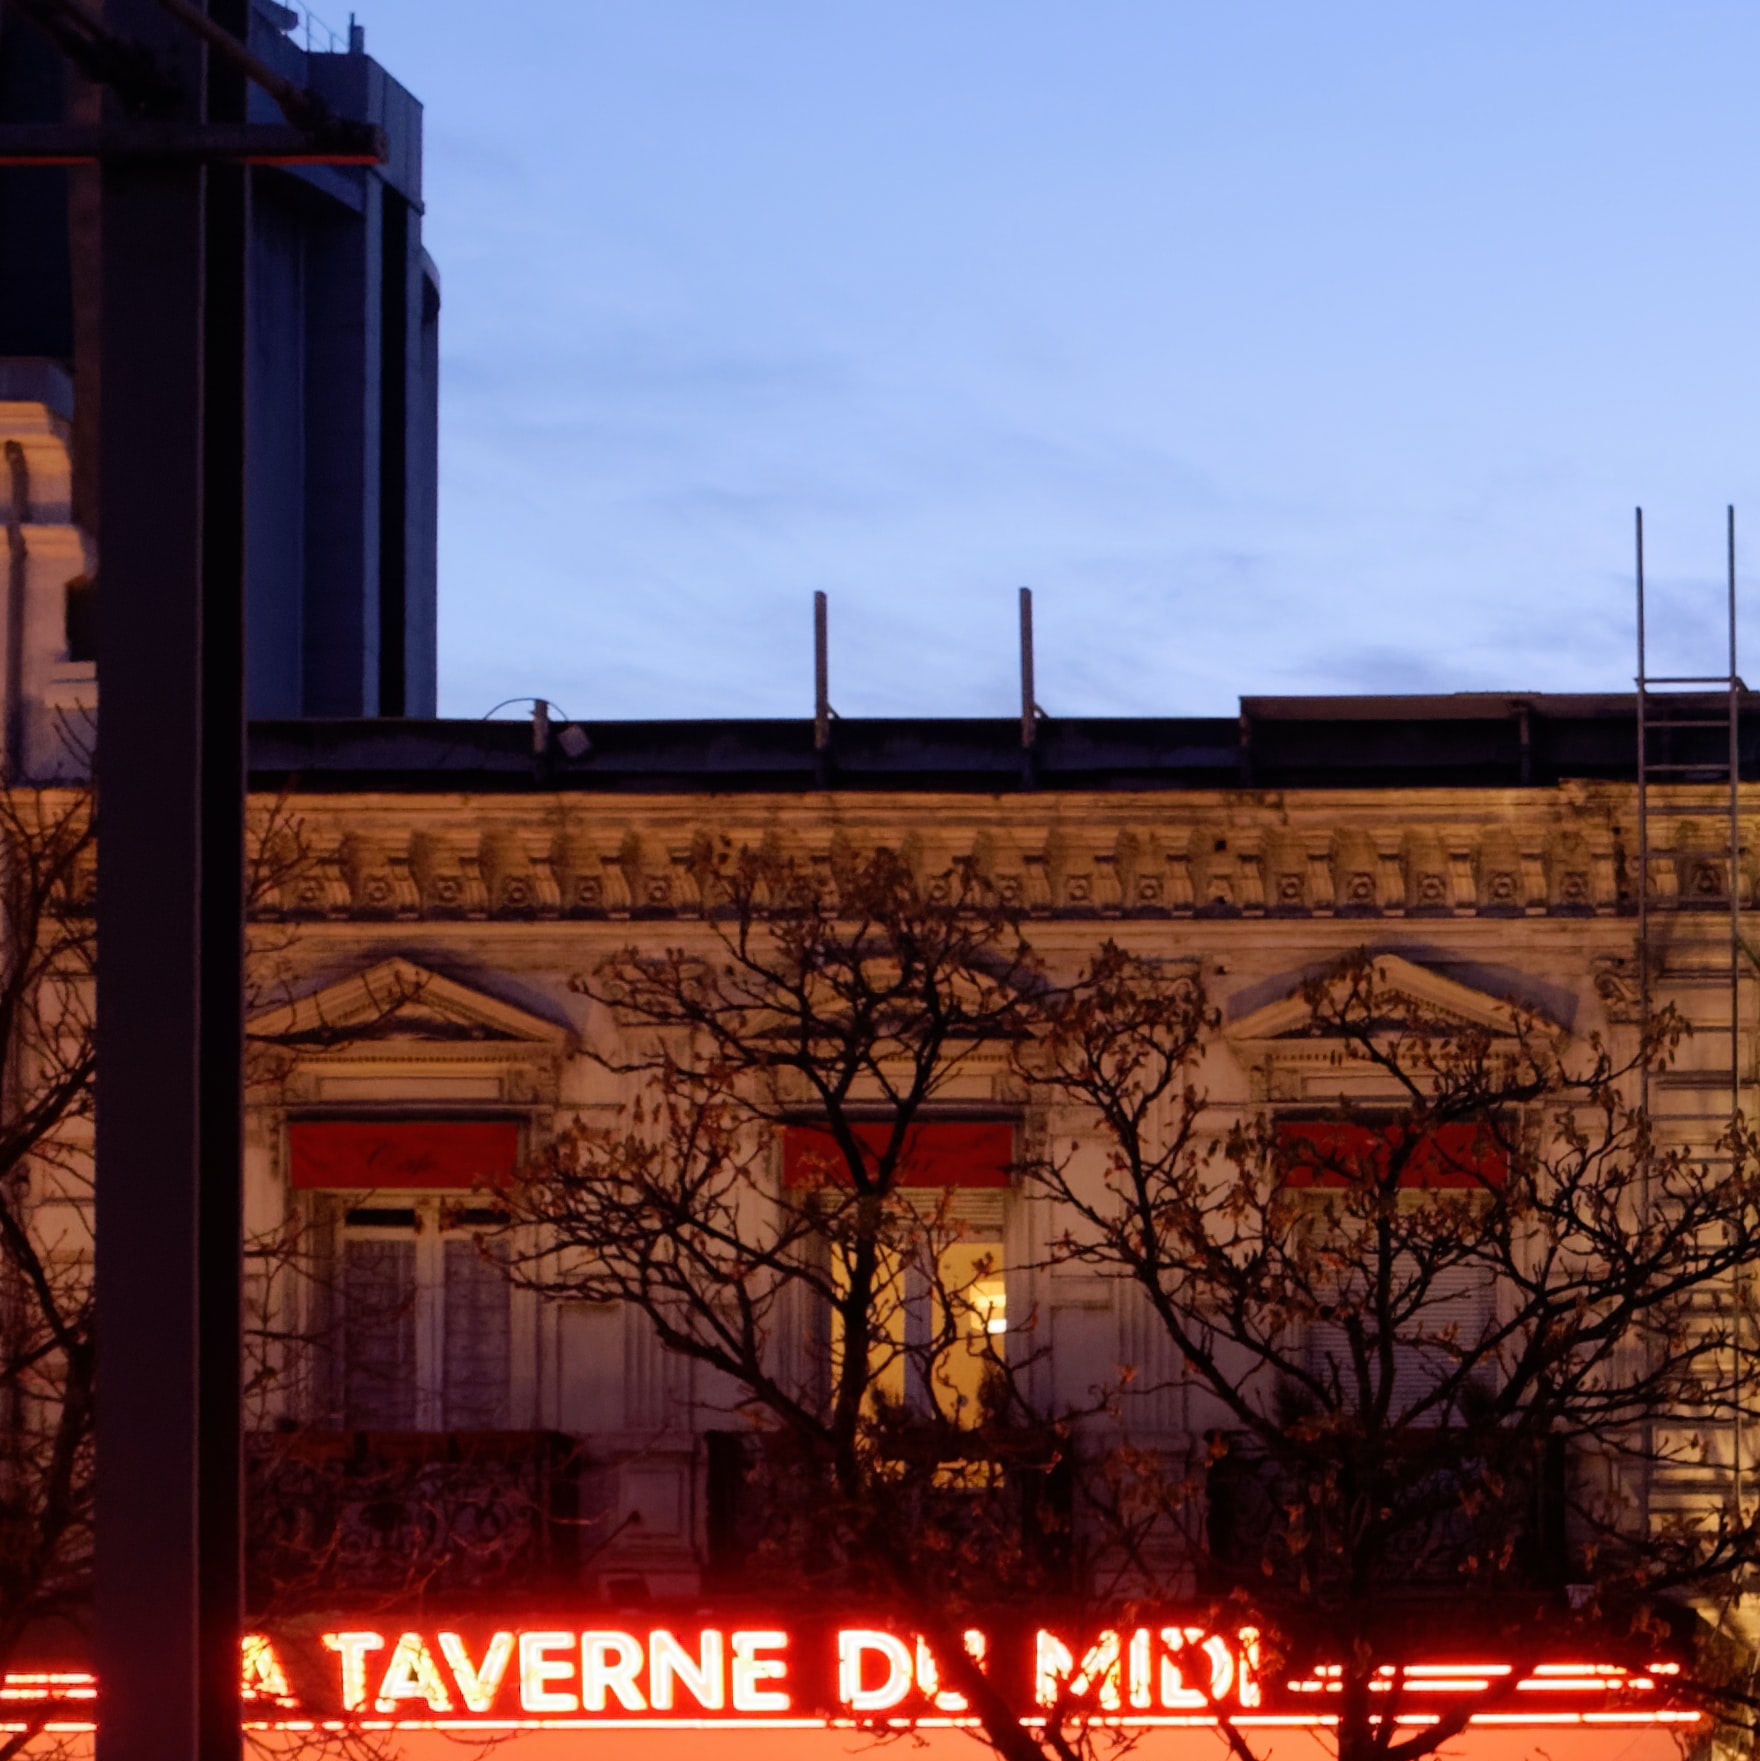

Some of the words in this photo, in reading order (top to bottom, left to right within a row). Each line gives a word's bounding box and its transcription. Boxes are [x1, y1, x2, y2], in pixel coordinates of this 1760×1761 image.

[241, 1633, 297, 1707] A
[322, 1630, 791, 1713] TAVERNE
[1036, 1627, 1261, 1709] MIDI
